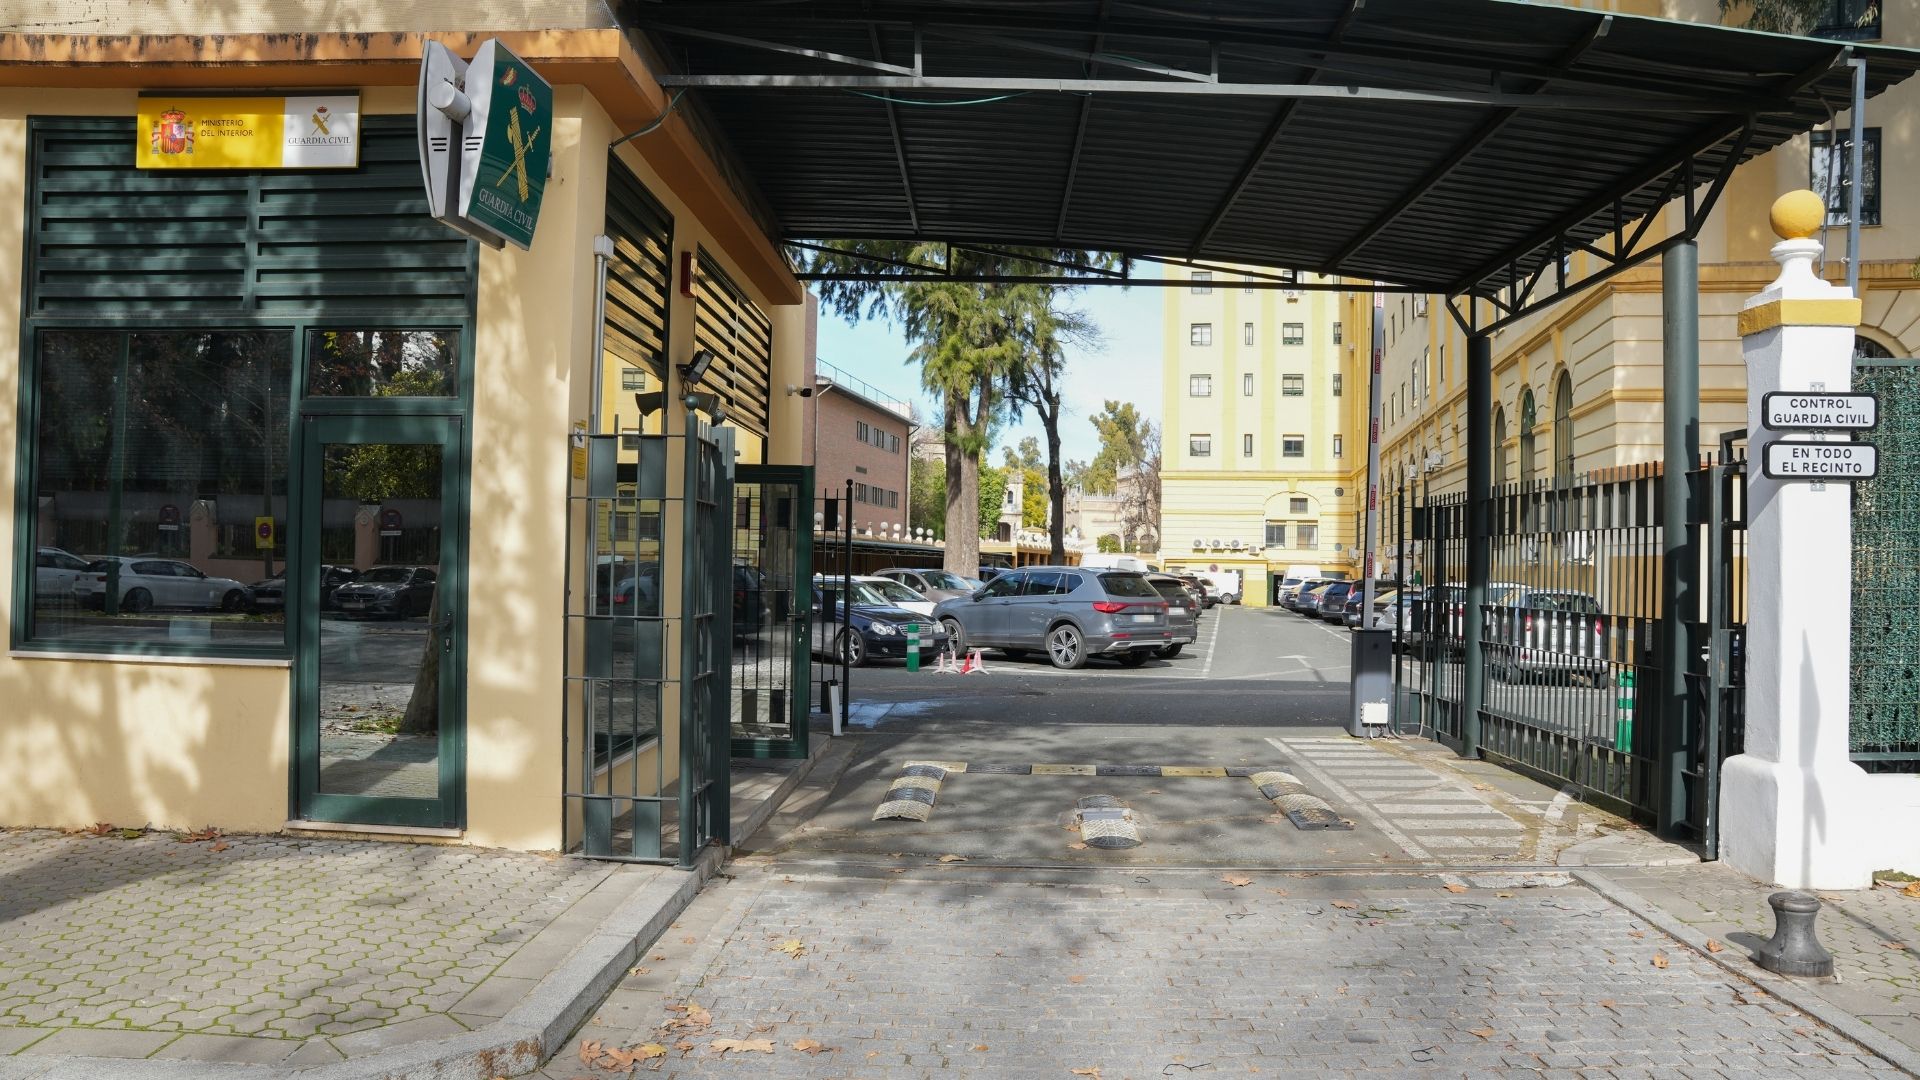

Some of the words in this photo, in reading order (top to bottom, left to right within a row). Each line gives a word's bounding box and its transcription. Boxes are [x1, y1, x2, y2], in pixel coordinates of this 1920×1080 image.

[201, 119, 244, 127] MINISTERIO
[201, 129, 215, 137] DEL
[217, 129, 254, 137] INTERIOR
[288, 136, 327, 145] GUARDIA
[328, 136, 351, 144] CIVIL
[479, 188, 513, 219] GUARDIA
[513, 209, 533, 230] CIVIL
[1790, 398, 1852, 409] CONTROL
[1773, 413, 1832, 424] GUARDIA
[1836, 413, 1869, 424] CIVIL
[1792, 447, 1810, 458] EN
[1815, 448, 1852, 459] TODO
[1782, 461, 1797, 473] EL
[1802, 462, 1862, 474] RECINTO
